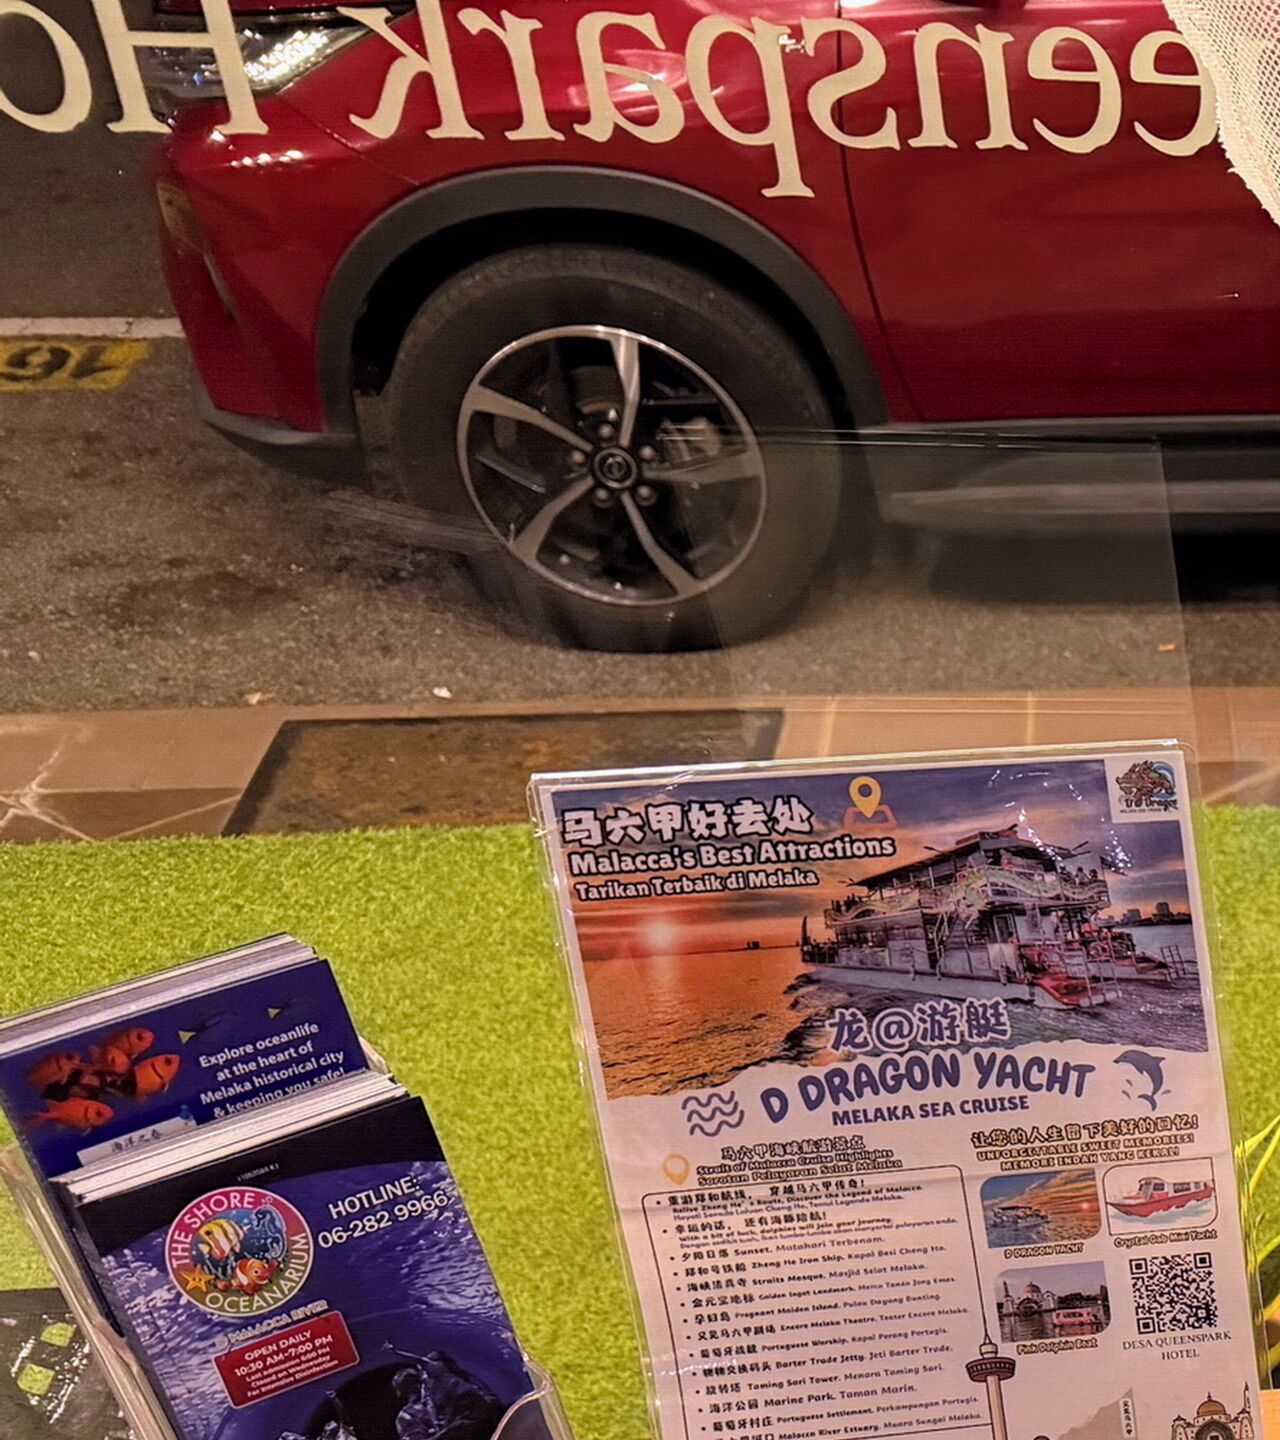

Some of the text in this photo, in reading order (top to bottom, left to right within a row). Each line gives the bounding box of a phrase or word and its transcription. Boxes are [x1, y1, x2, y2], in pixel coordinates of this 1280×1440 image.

[561, 797, 813, 848] 马六甲好去处
[570, 837, 895, 876] Malacca's Best Attractions
[575, 870, 819, 901] Tarikan Terbaik di Melaka
[200, 1023, 319, 1068] Explore oceanlife
[829, 998, 1011, 1051] 龙@游艇
[200, 1051, 344, 1105] Melaka historical city
[217, 1041, 314, 1081] at the heart of
[214, 1068, 345, 1118] & keeping you safe!
[760, 1052, 1096, 1123] D DRAGON YACHT
[833, 1096, 1029, 1125] MELAKA SEA CRUISE
[318, 1190, 450, 1249] 06-282 9966
[328, 1176, 421, 1220] HOTLINE:
[172, 1192, 254, 1268] THE SHORE
[206, 1233, 309, 1312] OCEANARIUM
[244, 1330, 312, 1360] OPEN DAILY
[1123, 1331, 1232, 1350] DESA QUEENSPARK
[1162, 1349, 1199, 1361] HOTEL
